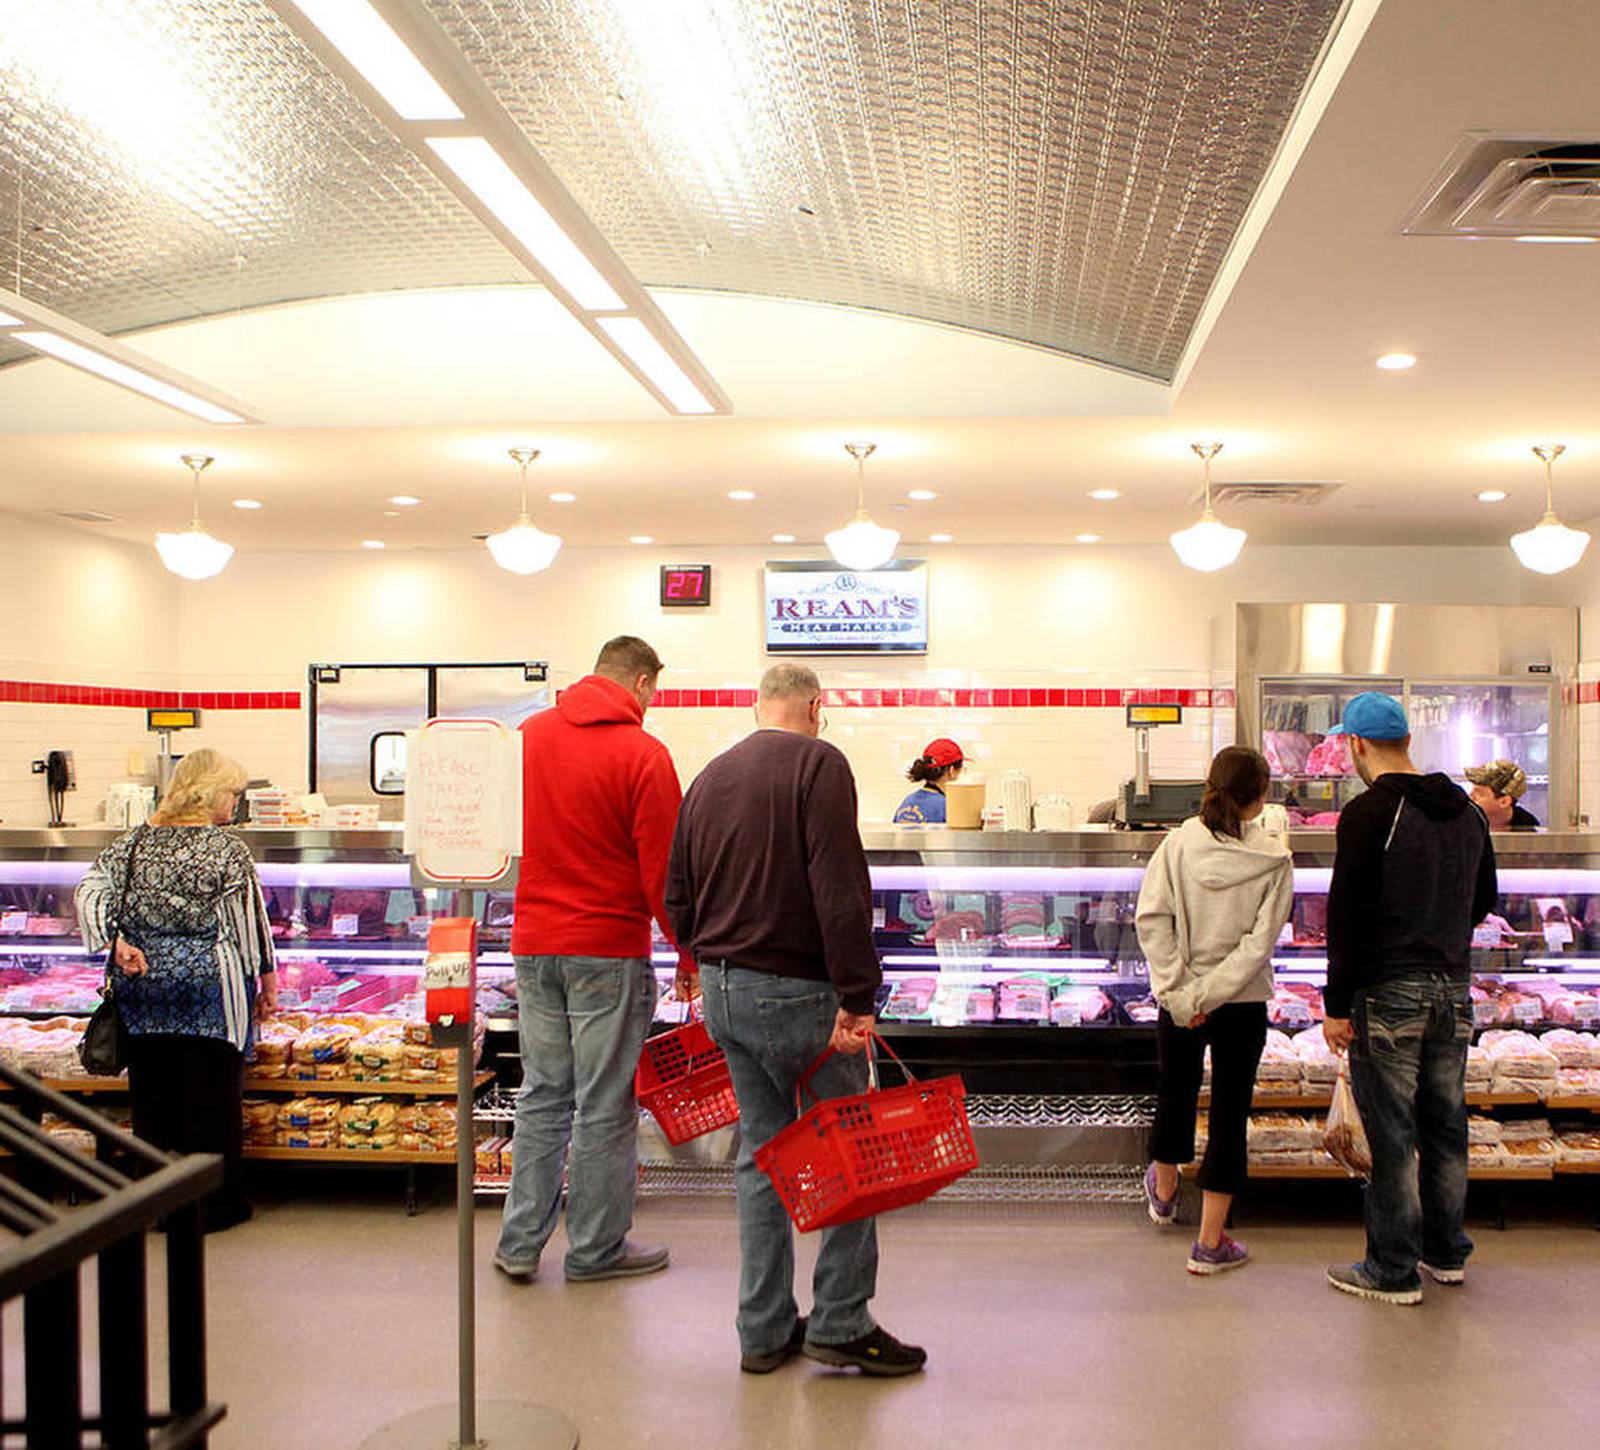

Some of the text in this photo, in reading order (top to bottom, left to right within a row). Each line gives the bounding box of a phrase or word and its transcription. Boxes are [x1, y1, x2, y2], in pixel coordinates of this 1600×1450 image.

[666, 572, 703, 597] 27
[770, 593, 919, 619] REAM'S
[418, 752, 481, 776] PLEASE
